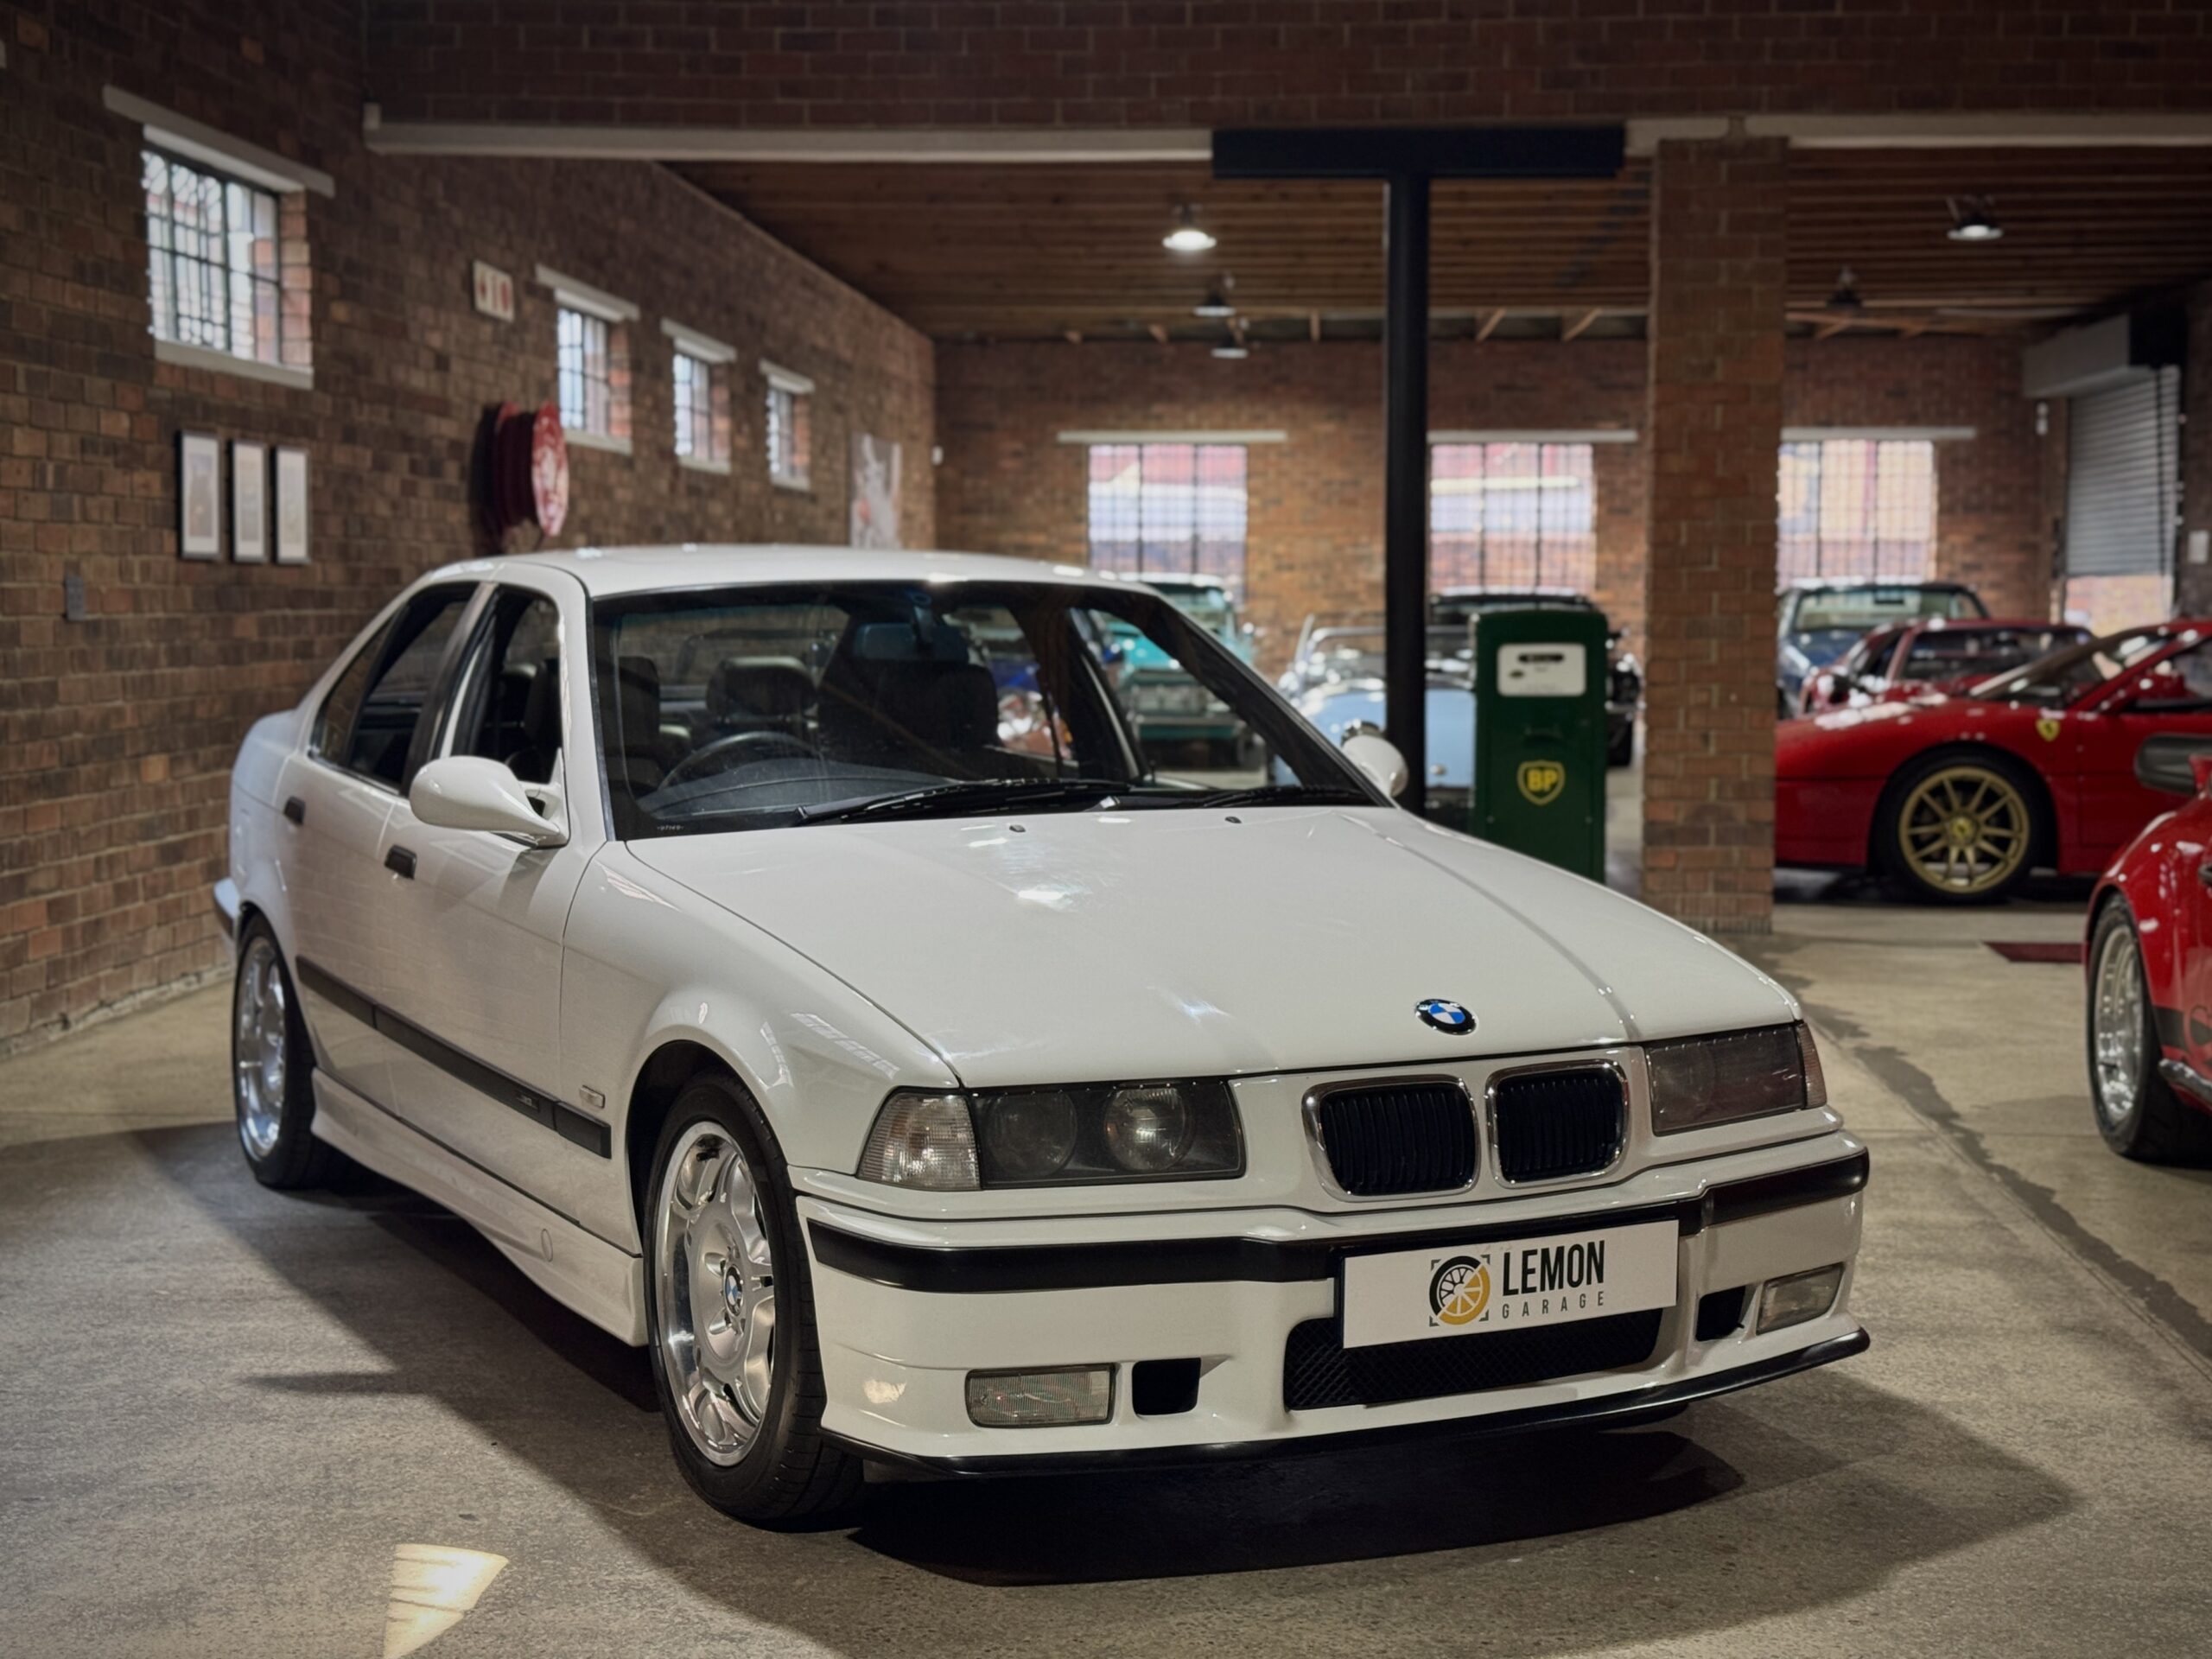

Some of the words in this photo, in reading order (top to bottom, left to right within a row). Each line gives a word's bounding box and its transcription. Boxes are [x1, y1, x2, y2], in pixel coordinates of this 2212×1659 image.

[1527, 768, 1557, 791] BP
[1503, 1240, 1605, 1296] LEMON
[1502, 1292, 1605, 1319] GARAGE
